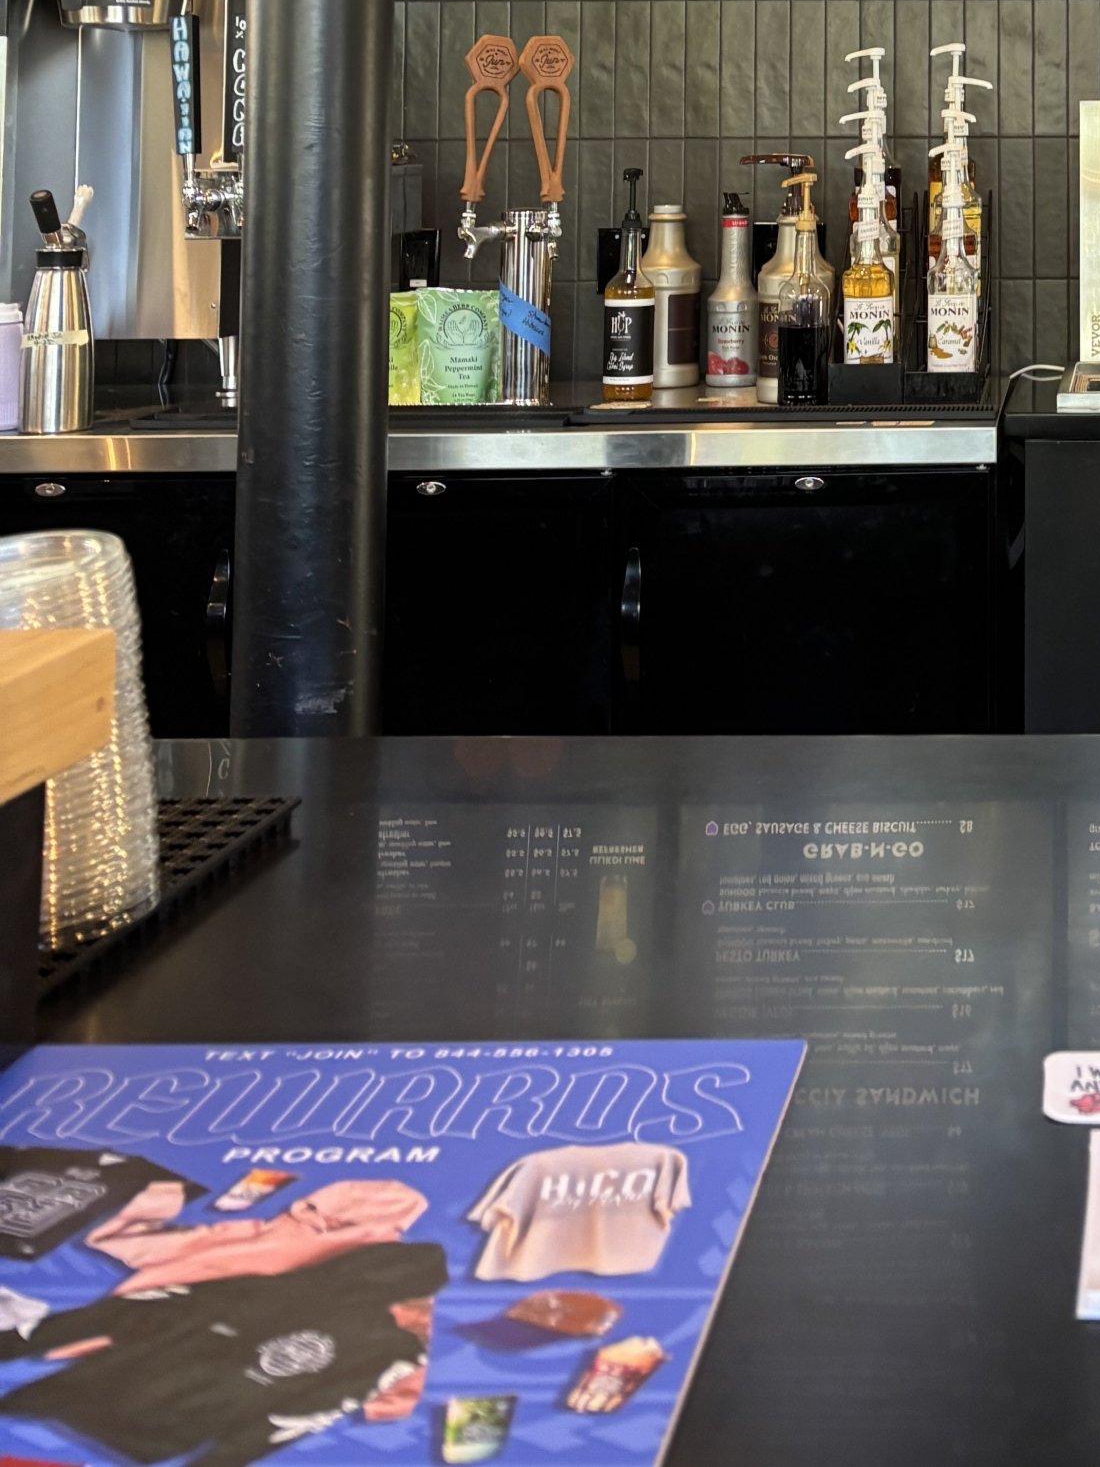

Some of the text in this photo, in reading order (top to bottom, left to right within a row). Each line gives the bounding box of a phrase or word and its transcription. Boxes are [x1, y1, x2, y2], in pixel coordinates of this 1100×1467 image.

[849, 310, 890, 319] MONIN
[930, 308, 969, 316] MONIN
[712, 325, 750, 333] MONIN
[857, 337, 880, 346] Vanilla
[938, 337, 961, 345] Caramel
[203, 1051, 276, 1061] TEXT
[285, 1049, 379, 1061] "JOIN"
[390, 1049, 425, 1059] TO
[3, 1064, 750, 1145] REWARDS
[222, 1147, 440, 1163] PROGRAM
